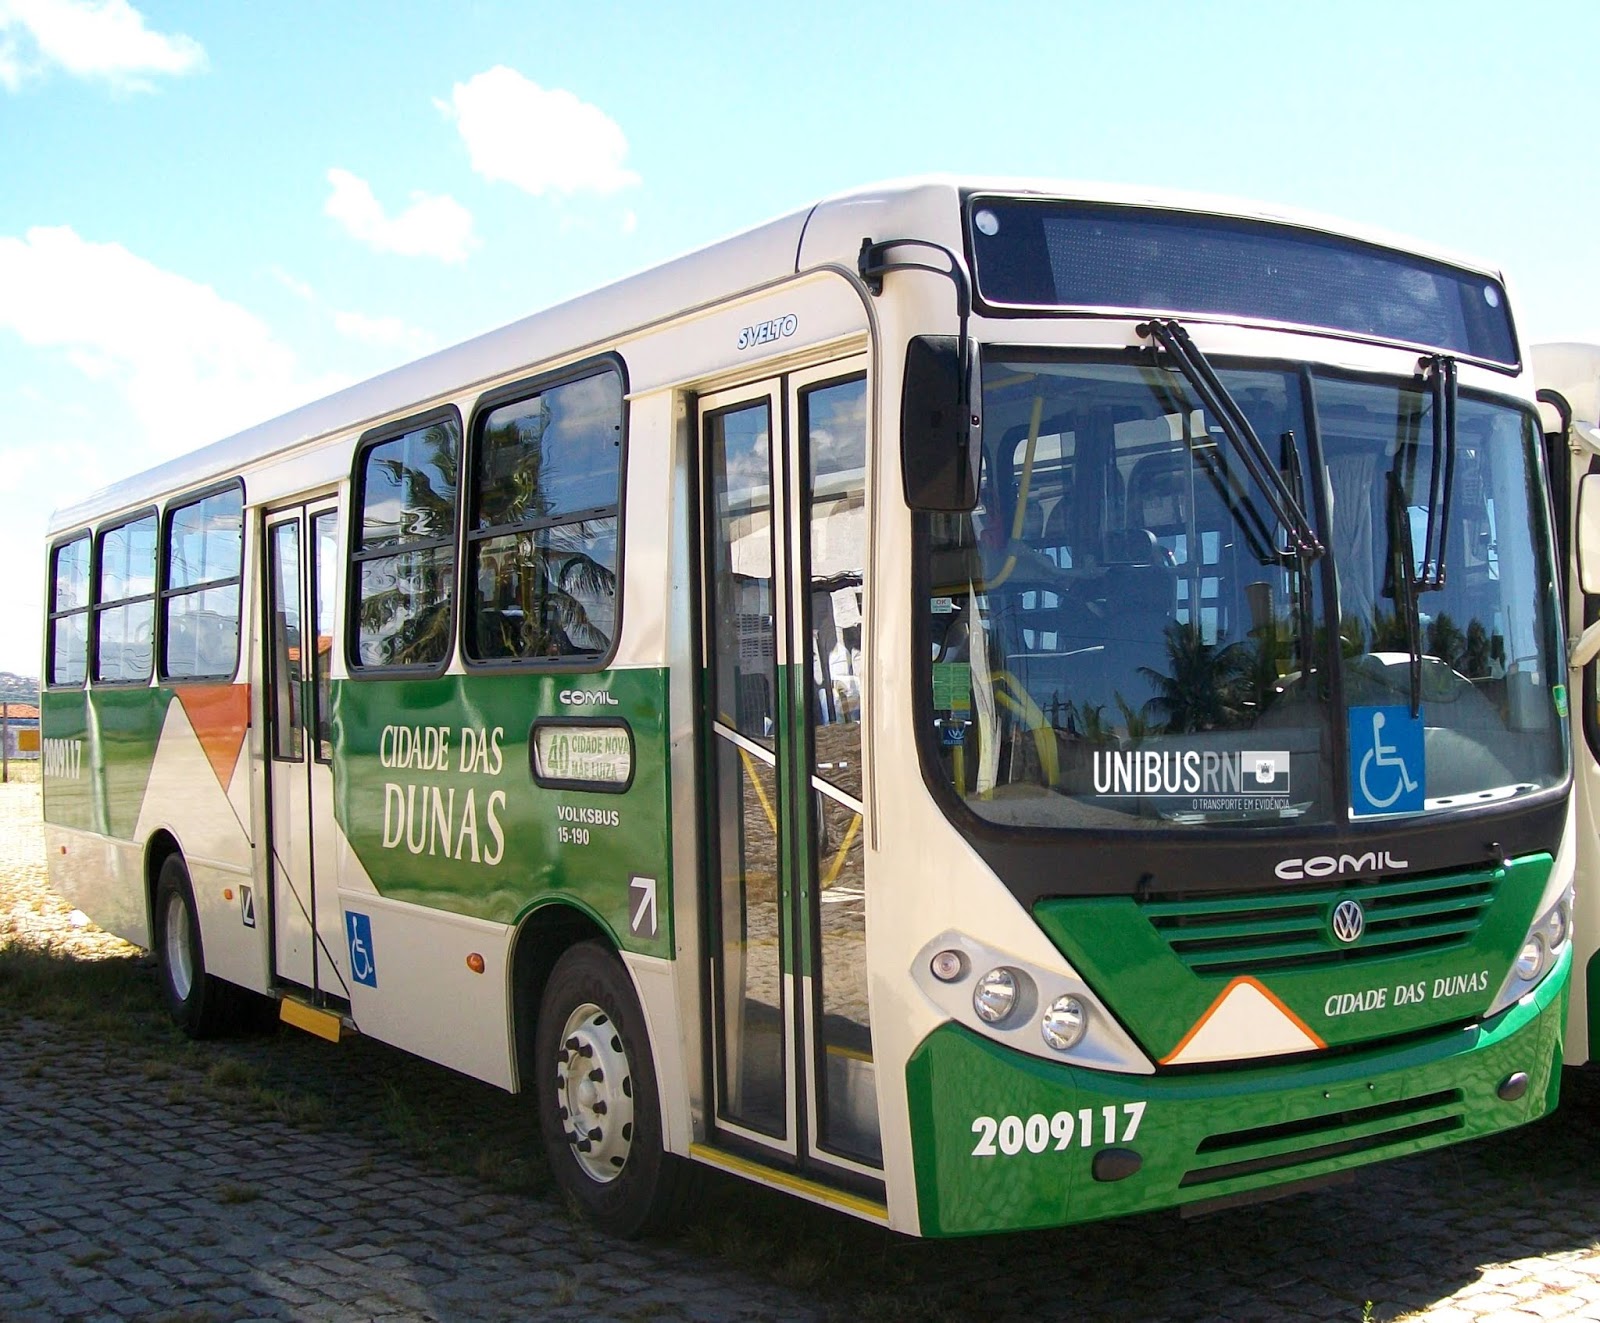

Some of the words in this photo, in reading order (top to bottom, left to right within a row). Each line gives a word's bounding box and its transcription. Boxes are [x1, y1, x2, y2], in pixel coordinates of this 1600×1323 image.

[737, 313, 798, 350] SVELTO
[559, 690, 619, 705] COMIL
[380, 725, 450, 771] CIDADE
[459, 726, 504, 776] DAS
[571, 735, 602, 754] CIDADE
[604, 736, 629, 755] NOVA
[382, 782, 506, 866] DUNAS
[557, 805, 620, 827] VOLKSBUS
[557, 826, 590, 846] 15-190
[1274, 851, 1409, 880] COMIL
[1324, 987, 1388, 1017] CIDADE
[1393, 981, 1426, 1005] DAS
[1432, 970, 1489, 999] DUNAS
[971, 1101, 1147, 1156] 2009117
